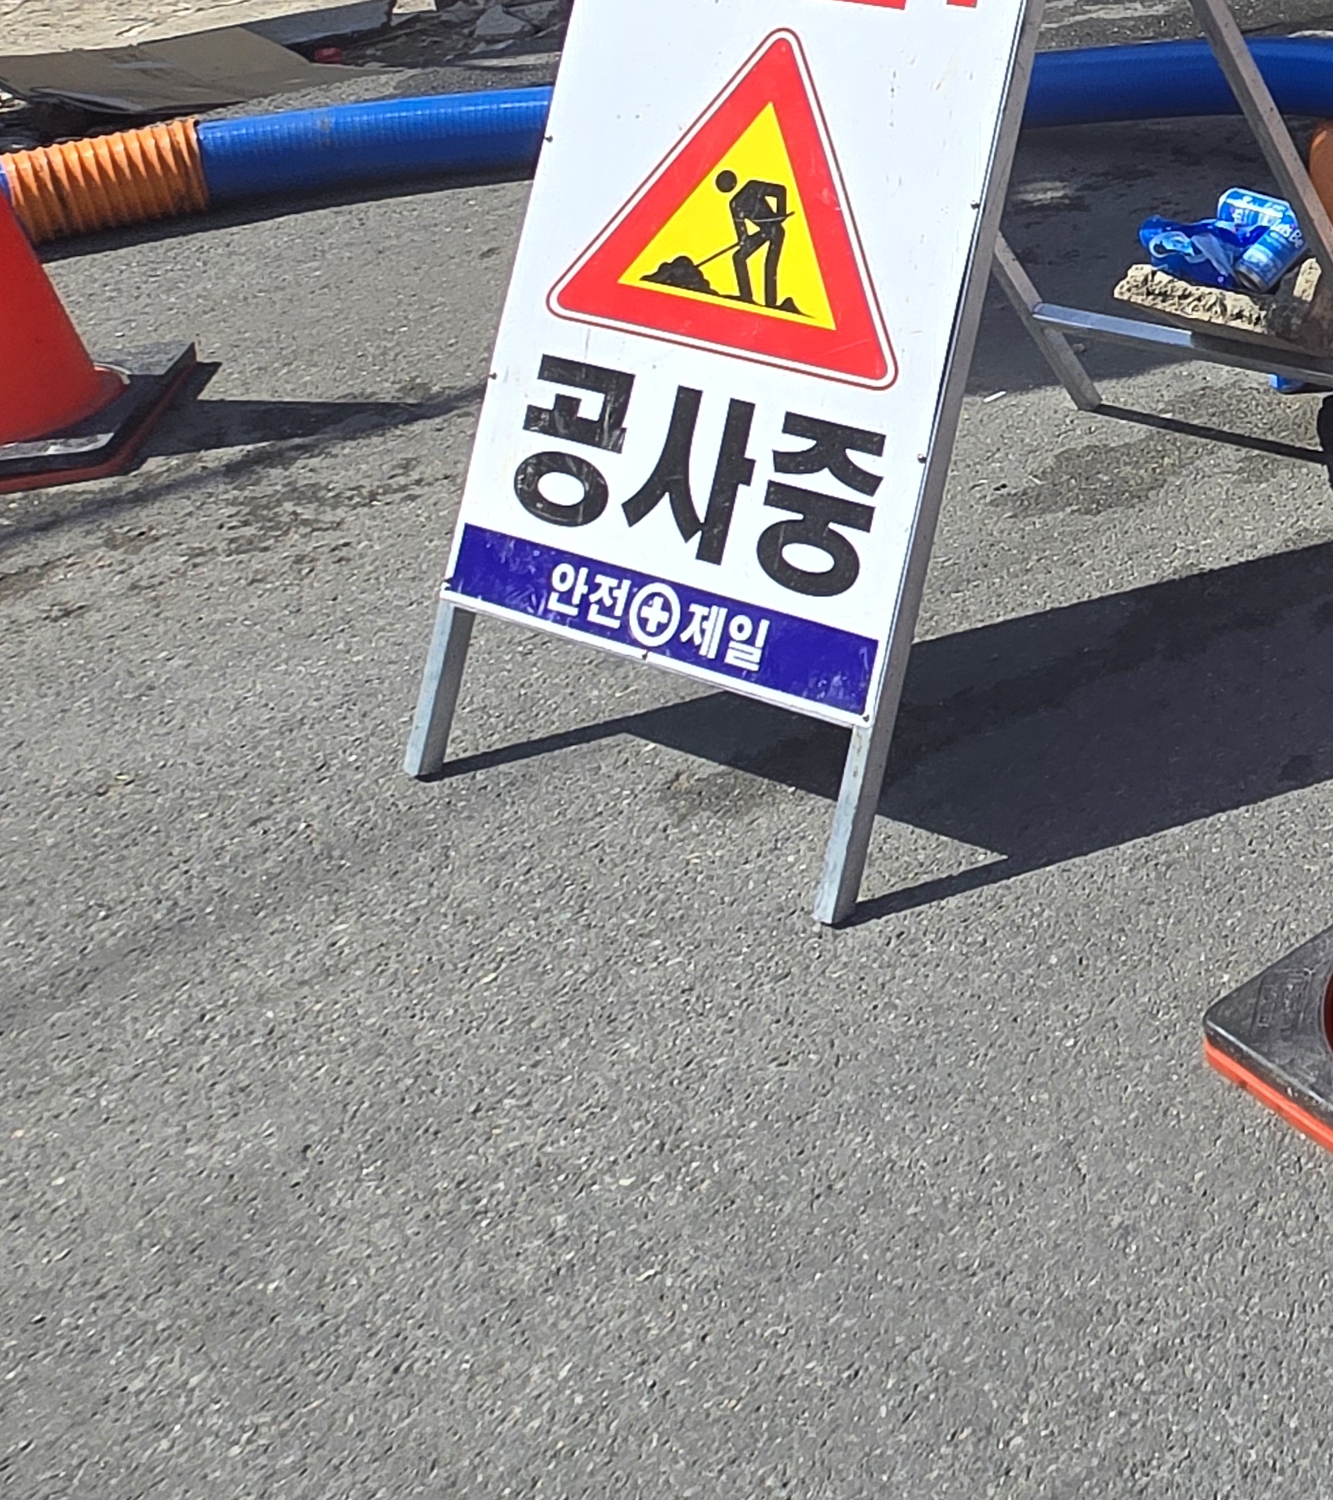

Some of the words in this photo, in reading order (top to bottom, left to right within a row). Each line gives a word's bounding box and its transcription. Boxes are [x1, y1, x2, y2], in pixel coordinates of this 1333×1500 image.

[513, 355, 887, 598] 공사중
[547, 563, 632, 629] 안전
[679, 603, 770, 671] 제일
